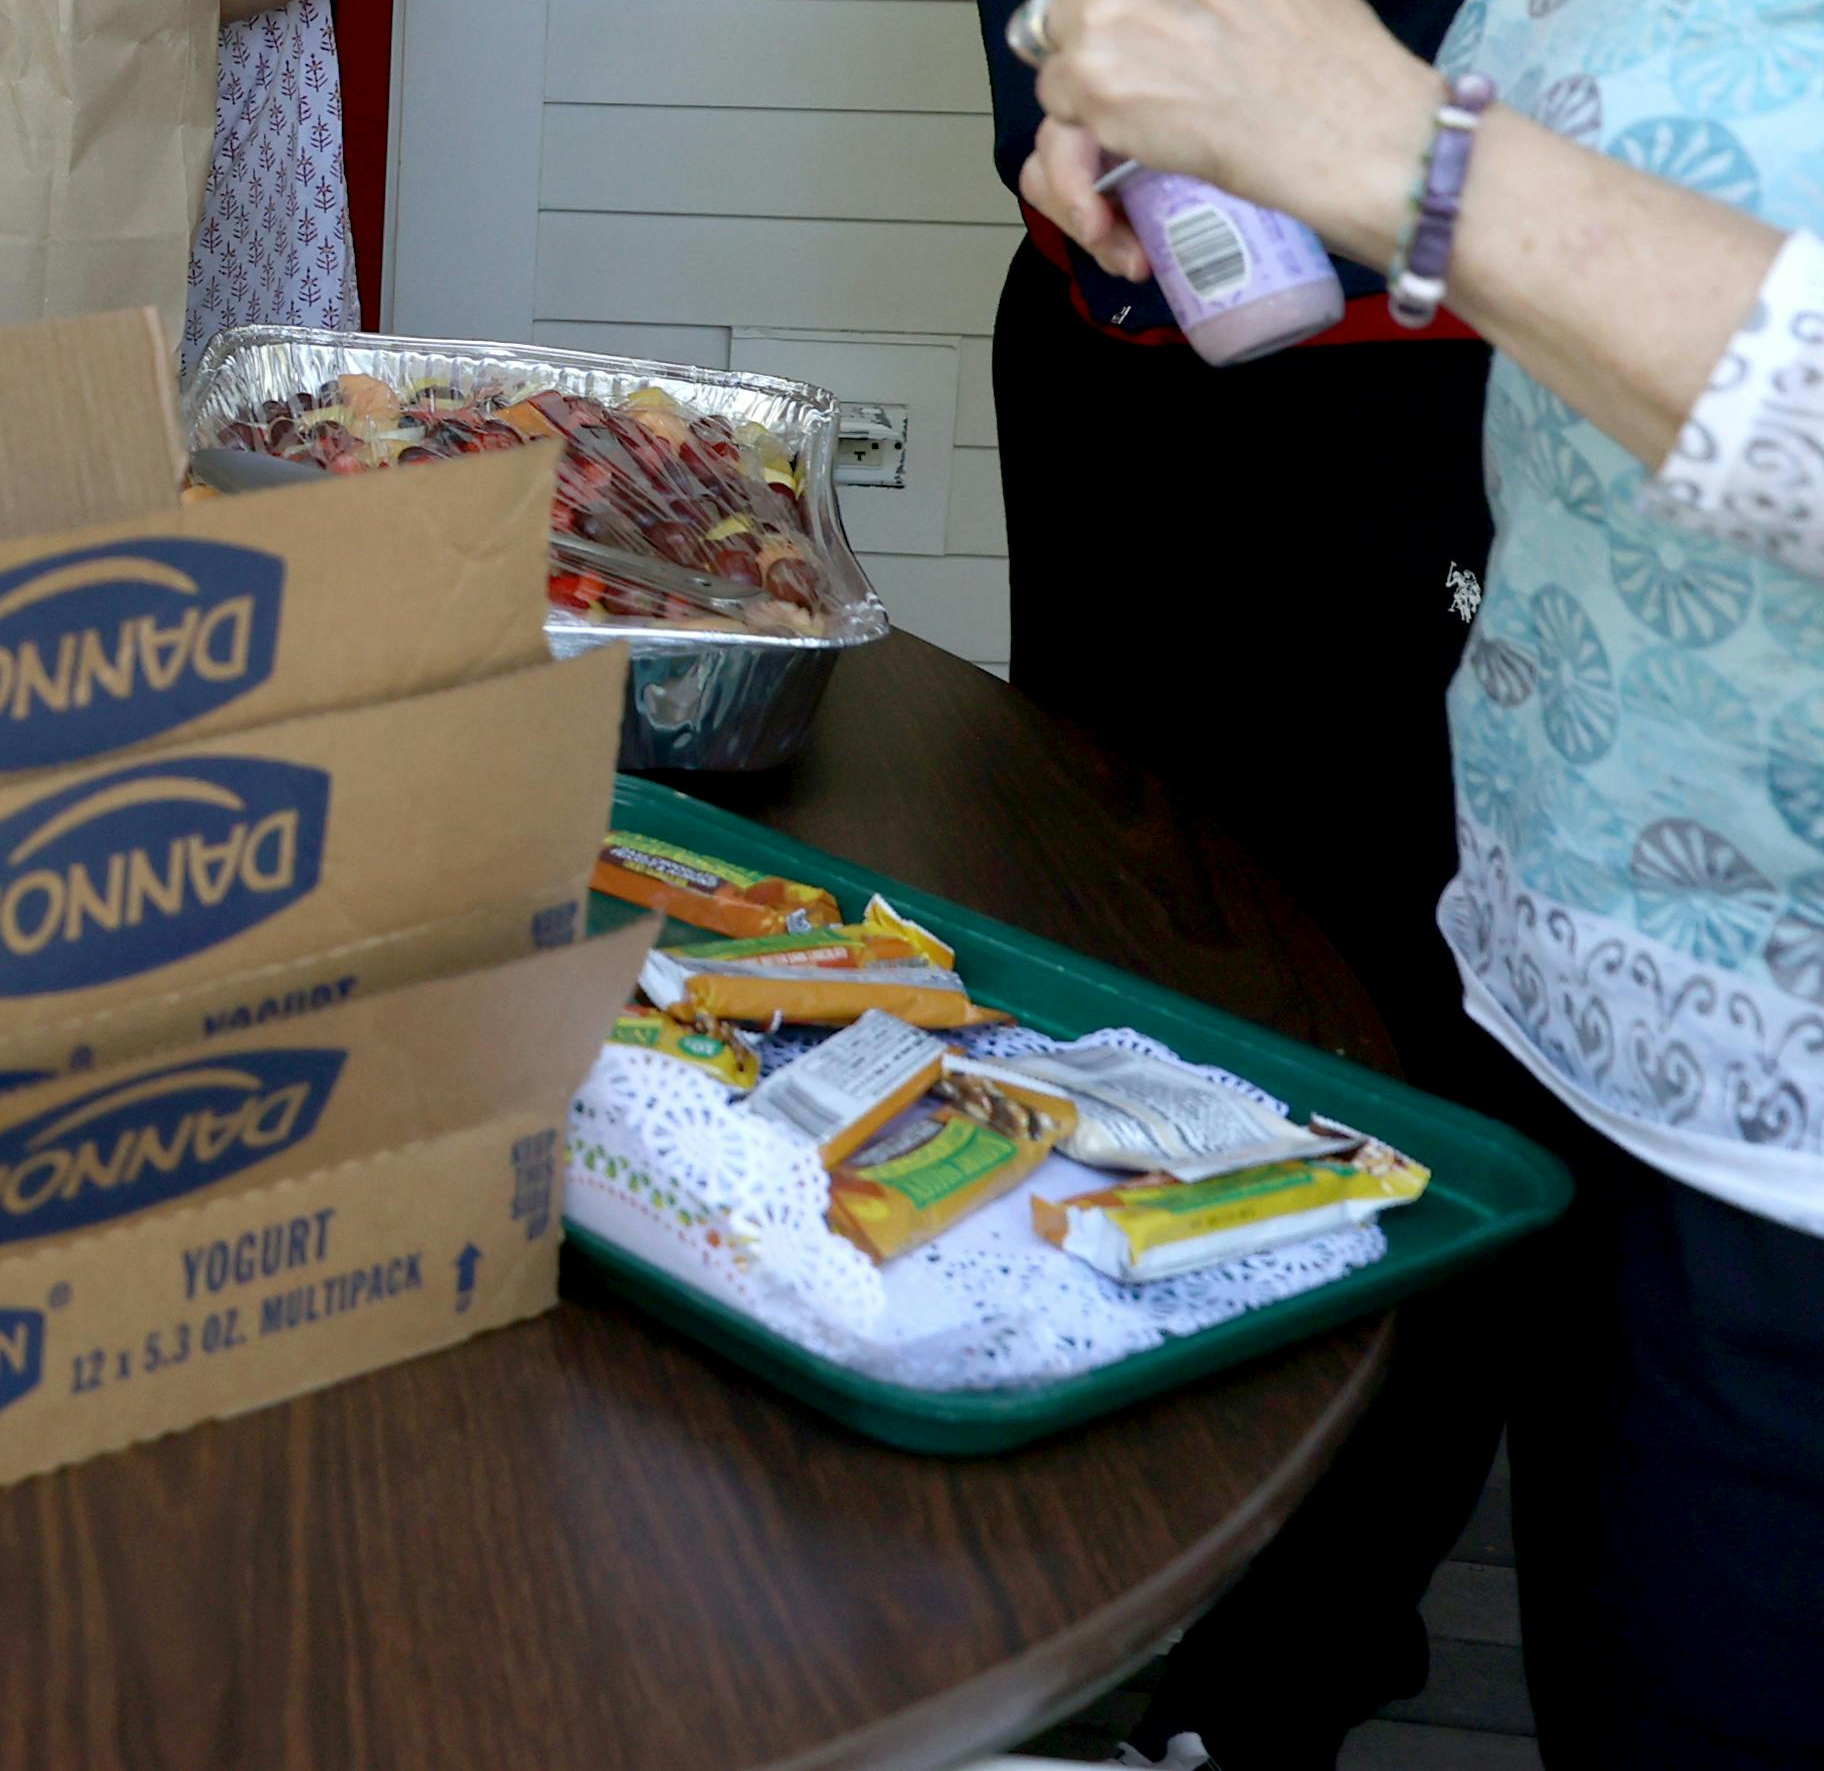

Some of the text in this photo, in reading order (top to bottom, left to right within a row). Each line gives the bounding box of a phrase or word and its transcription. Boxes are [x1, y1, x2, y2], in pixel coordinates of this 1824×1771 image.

[183, 1209, 335, 1299] YOGURT
[71, 1350, 102, 1394] 12
[143, 1322, 191, 1374] 5.3
[202, 1309, 247, 1355] OZ.
[259, 1253, 423, 1337] MULTIPACK
